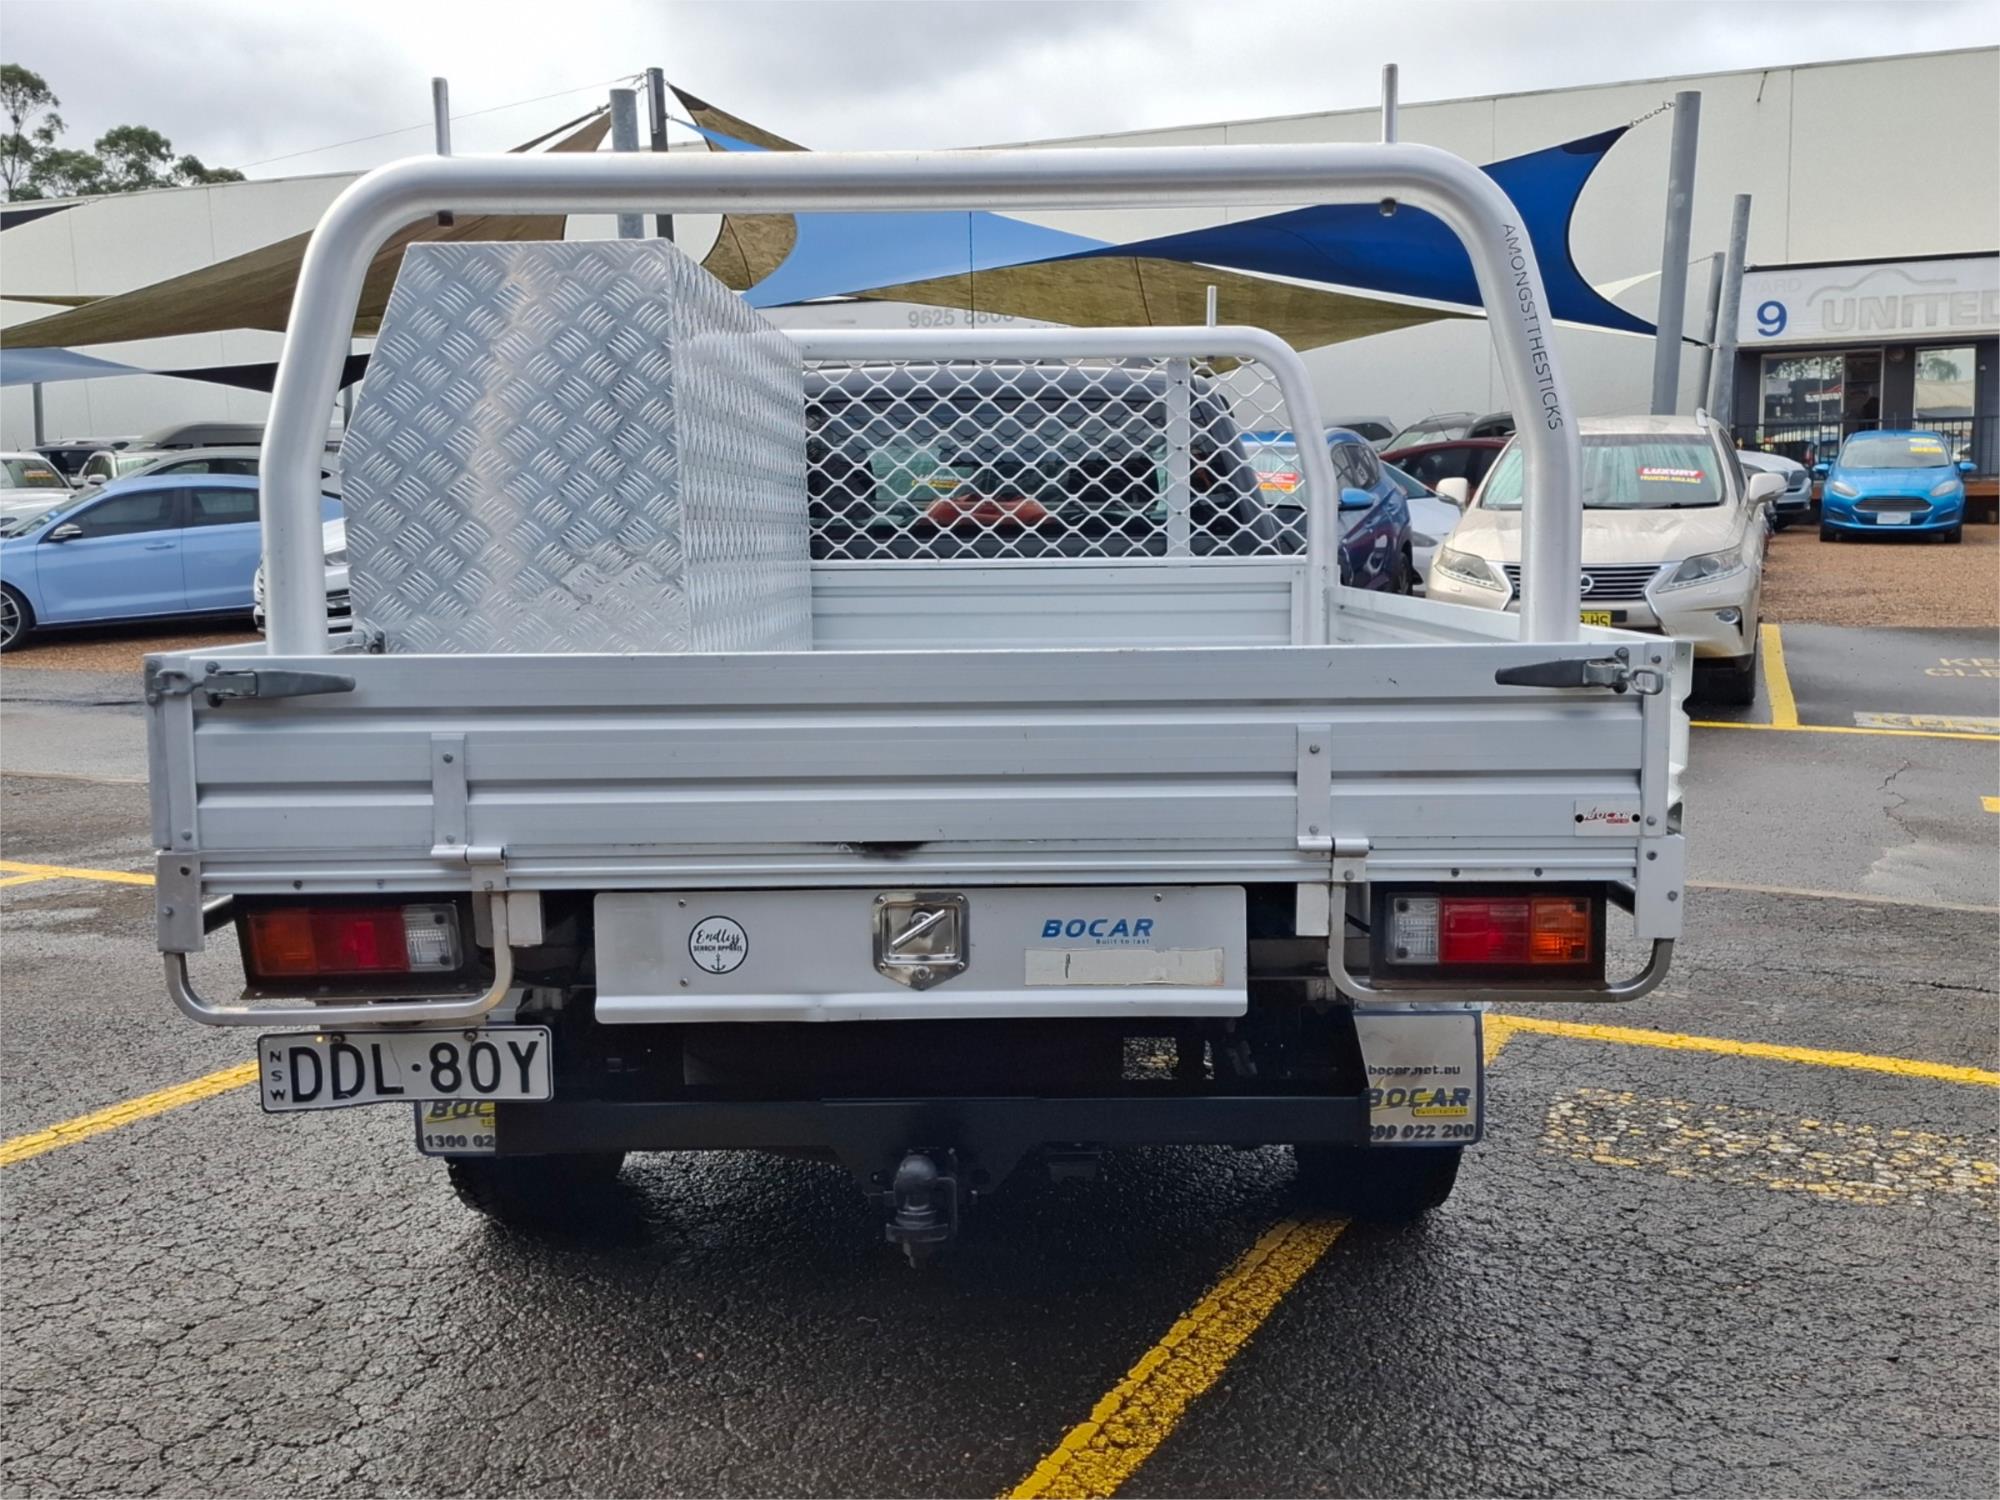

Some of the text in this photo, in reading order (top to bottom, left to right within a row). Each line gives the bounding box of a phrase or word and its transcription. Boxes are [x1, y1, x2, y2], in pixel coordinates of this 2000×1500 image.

[908, 309, 955, 329] 9625
[1756, 300, 1788, 337] 9
[1940, 658, 2000, 666] KE
[1041, 918, 1154, 938] BOCAR
[1369, 1087, 1471, 1108] BOCAR
[425, 1134, 468, 1148] 1300
[1402, 1124, 1436, 1139] 022
[1441, 1123, 1474, 1138] 200
